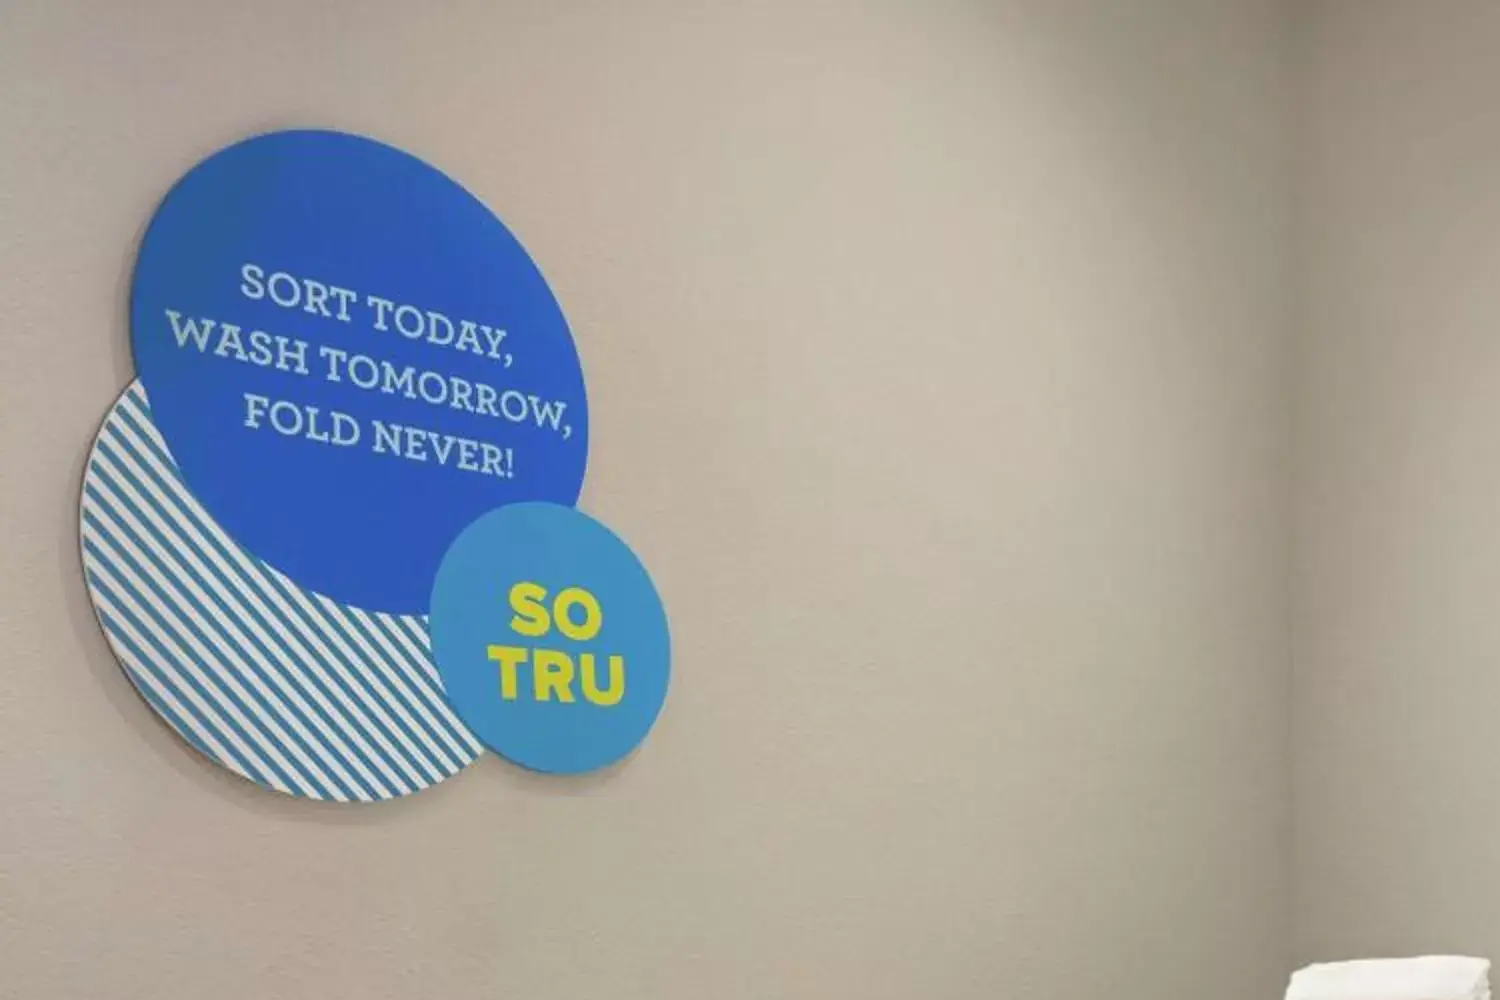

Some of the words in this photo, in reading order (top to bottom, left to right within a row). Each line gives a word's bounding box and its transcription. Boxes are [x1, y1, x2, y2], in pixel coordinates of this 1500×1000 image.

[240, 262, 357, 322] SORT
[367, 295, 514, 368] TODAY,
[164, 308, 309, 376] WASH
[319, 345, 573, 440] TOMORROW,
[242, 392, 361, 447] FOLD
[371, 419, 515, 479] NEVER!
[508, 581, 603, 642] SO
[487, 645, 626, 706] TRU
